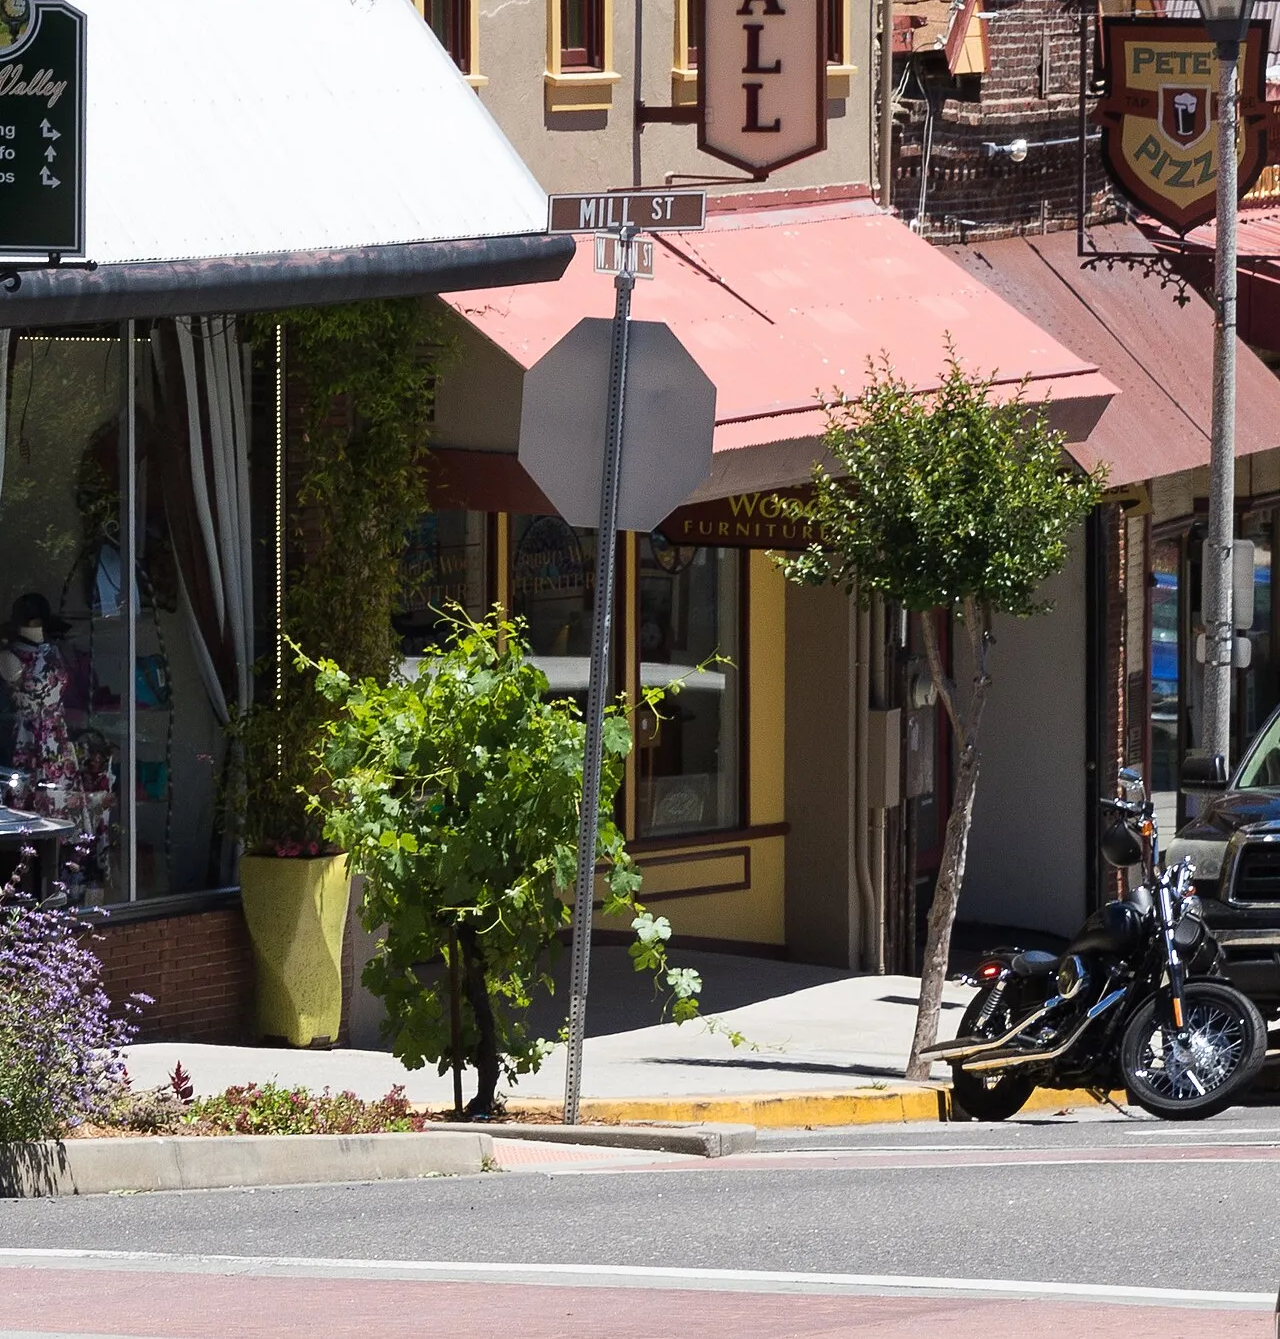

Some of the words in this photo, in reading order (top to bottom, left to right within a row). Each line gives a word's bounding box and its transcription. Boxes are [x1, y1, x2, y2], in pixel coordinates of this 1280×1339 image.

[1133, 133, 1218, 189] PIZZ
[579, 197, 635, 228] MILL
[651, 196, 675, 220] ST
[642, 242, 653, 268] ST
[683, 519, 833, 542] FURNITURE
